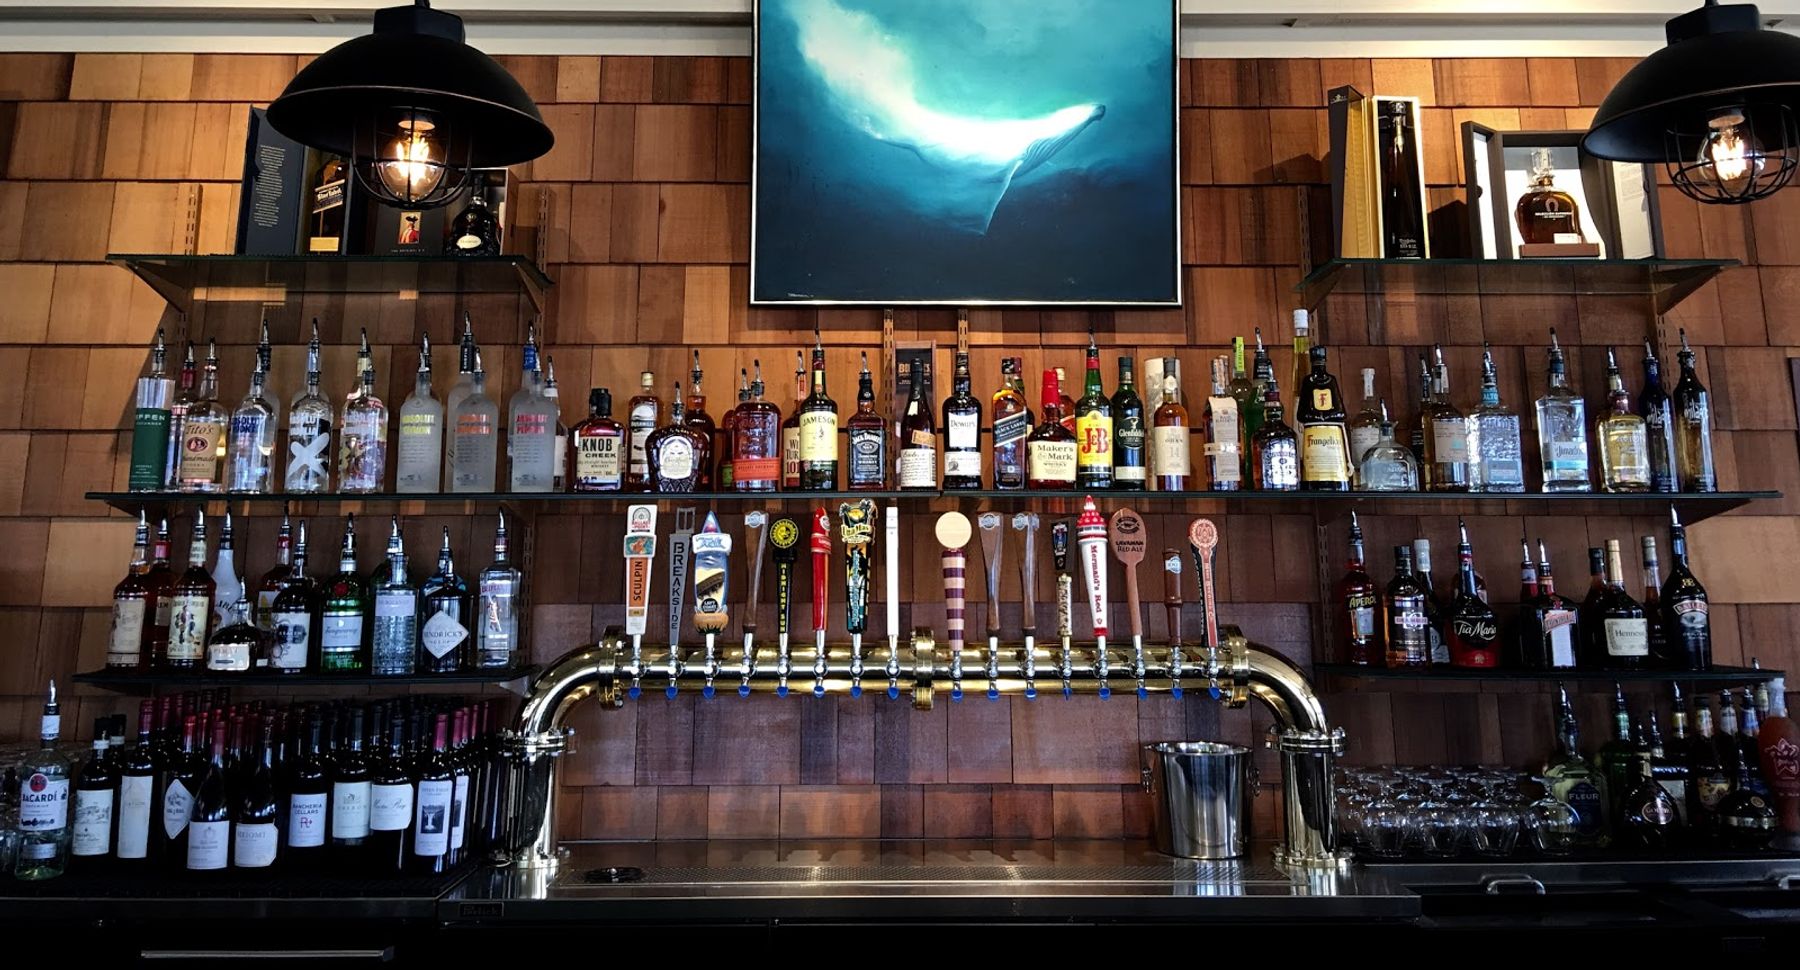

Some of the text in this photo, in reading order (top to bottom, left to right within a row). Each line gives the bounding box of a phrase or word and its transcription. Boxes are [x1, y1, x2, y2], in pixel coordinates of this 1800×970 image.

[802, 415, 836, 427] JAMESON
[186, 424, 214, 435] Tito's
[582, 438, 613, 452] KNOB
[789, 440, 799, 448] WI
[1037, 444, 1074, 452] Maker's
[786, 450, 799, 459] TUR
[1048, 453, 1073, 461] Mark
[786, 461, 800, 473] 101
[633, 561, 643, 601] SCULPIN
[1090, 545, 1102, 613] Mermaid's Red
[671, 541, 685, 630] BREAKSIDE
[1615, 629, 1646, 637] Henness
[1568, 793, 1600, 801] FLEUR
